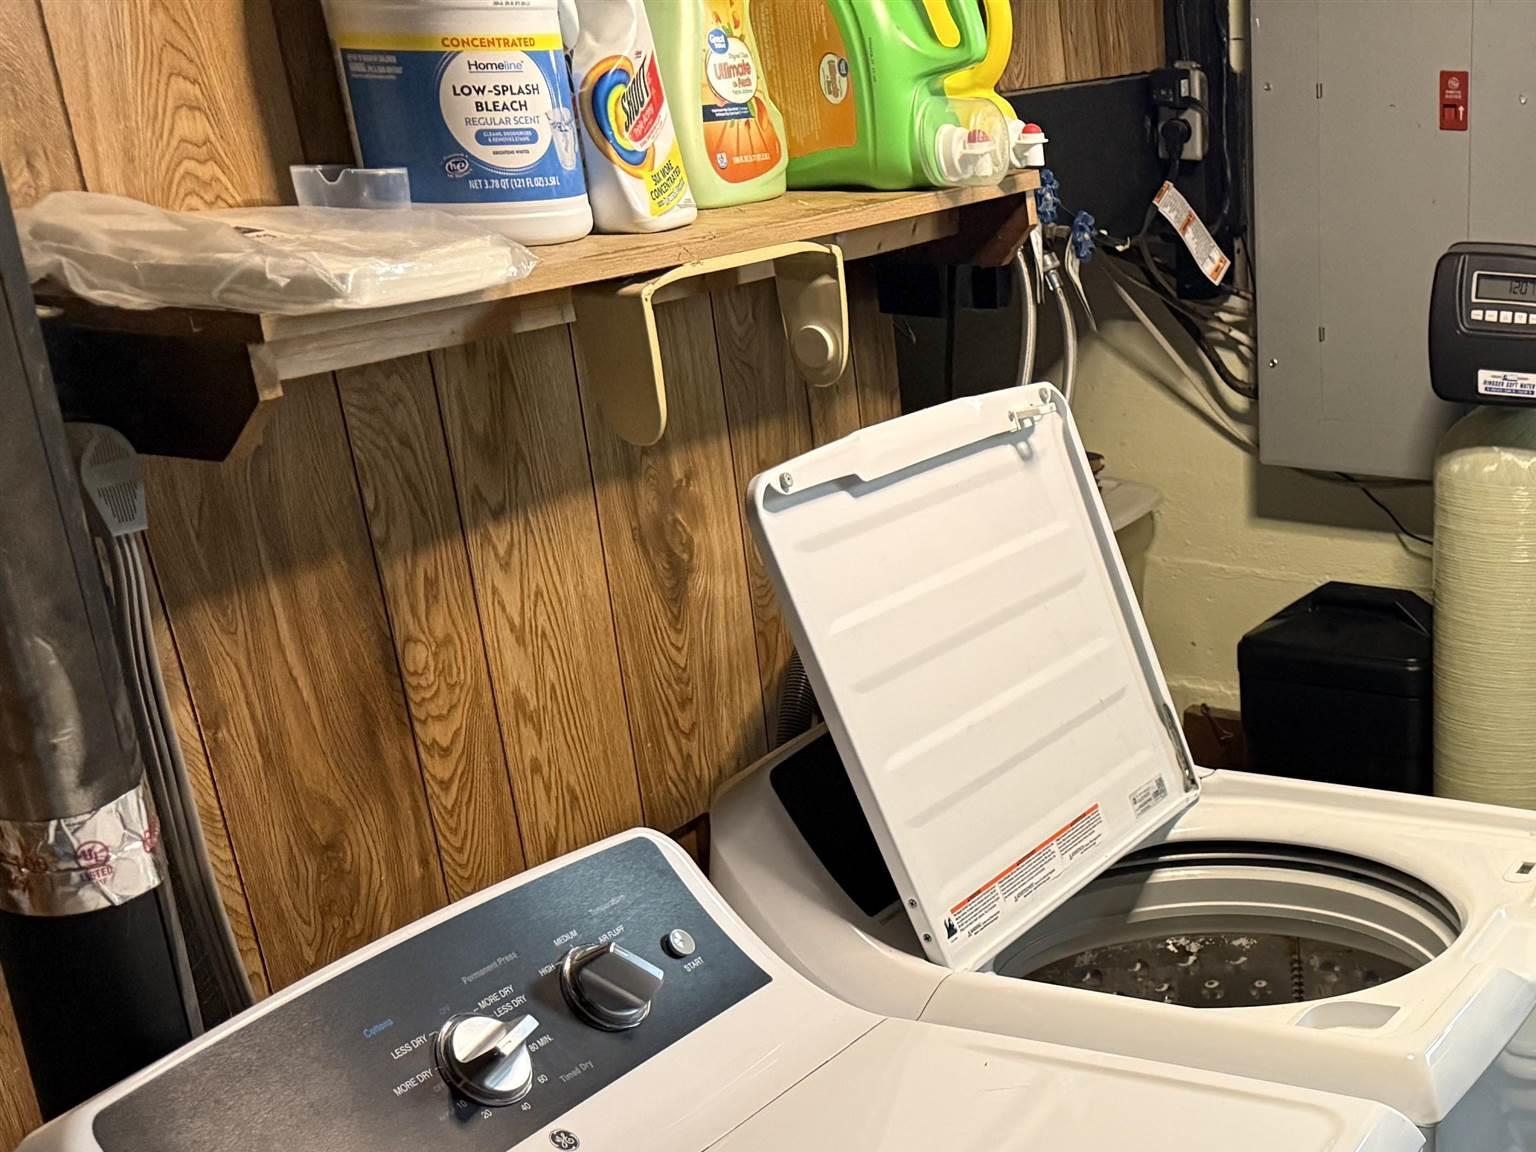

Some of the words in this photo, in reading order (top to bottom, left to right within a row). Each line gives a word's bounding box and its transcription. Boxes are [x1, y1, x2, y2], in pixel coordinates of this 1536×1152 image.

[441, 36, 536, 48] CONCENTRATED
[467, 60, 523, 70] Homeline
[452, 84, 540, 97] LOW-SPLASH
[475, 100, 528, 112] BLEACH
[465, 116, 511, 127] REGULAR
[513, 115, 540, 125] SCENT
[469, 179, 482, 189] NET
[484, 179, 500, 189] 3.78
[500, 179, 510, 188] QT
[511, 178, 525, 190] (121
[527, 178, 534, 188] FL
[553, 929, 578, 947] MEDIUM
[598, 934, 609, 944] AIR
[608, 924, 625, 939] FLUFF
[461, 958, 498, 984] Permanent
[498, 952, 518, 966] Press
[538, 962, 556, 977] HIGH
[683, 956, 704, 973] START
[478, 990, 499, 1009] MORE
[499, 984, 515, 999] DRY
[493, 1003, 512, 1018] LESS
[511, 994, 527, 1009] DRY
[363, 1018, 393, 1039] Cottons
[390, 1044, 412, 1060] LESS
[411, 1033, 428, 1049] DRY
[528, 1042, 538, 1052] 80
[537, 1074, 548, 1084] 60
[559, 1067, 580, 1084] Timed
[579, 1060, 594, 1074] Dry
[392, 1076, 417, 1097] MORE
[416, 1068, 433, 1083] DRY
[457, 1100, 467, 1109] 10
[520, 1102, 531, 1111] 40
[481, 1109, 492, 1120] 20
